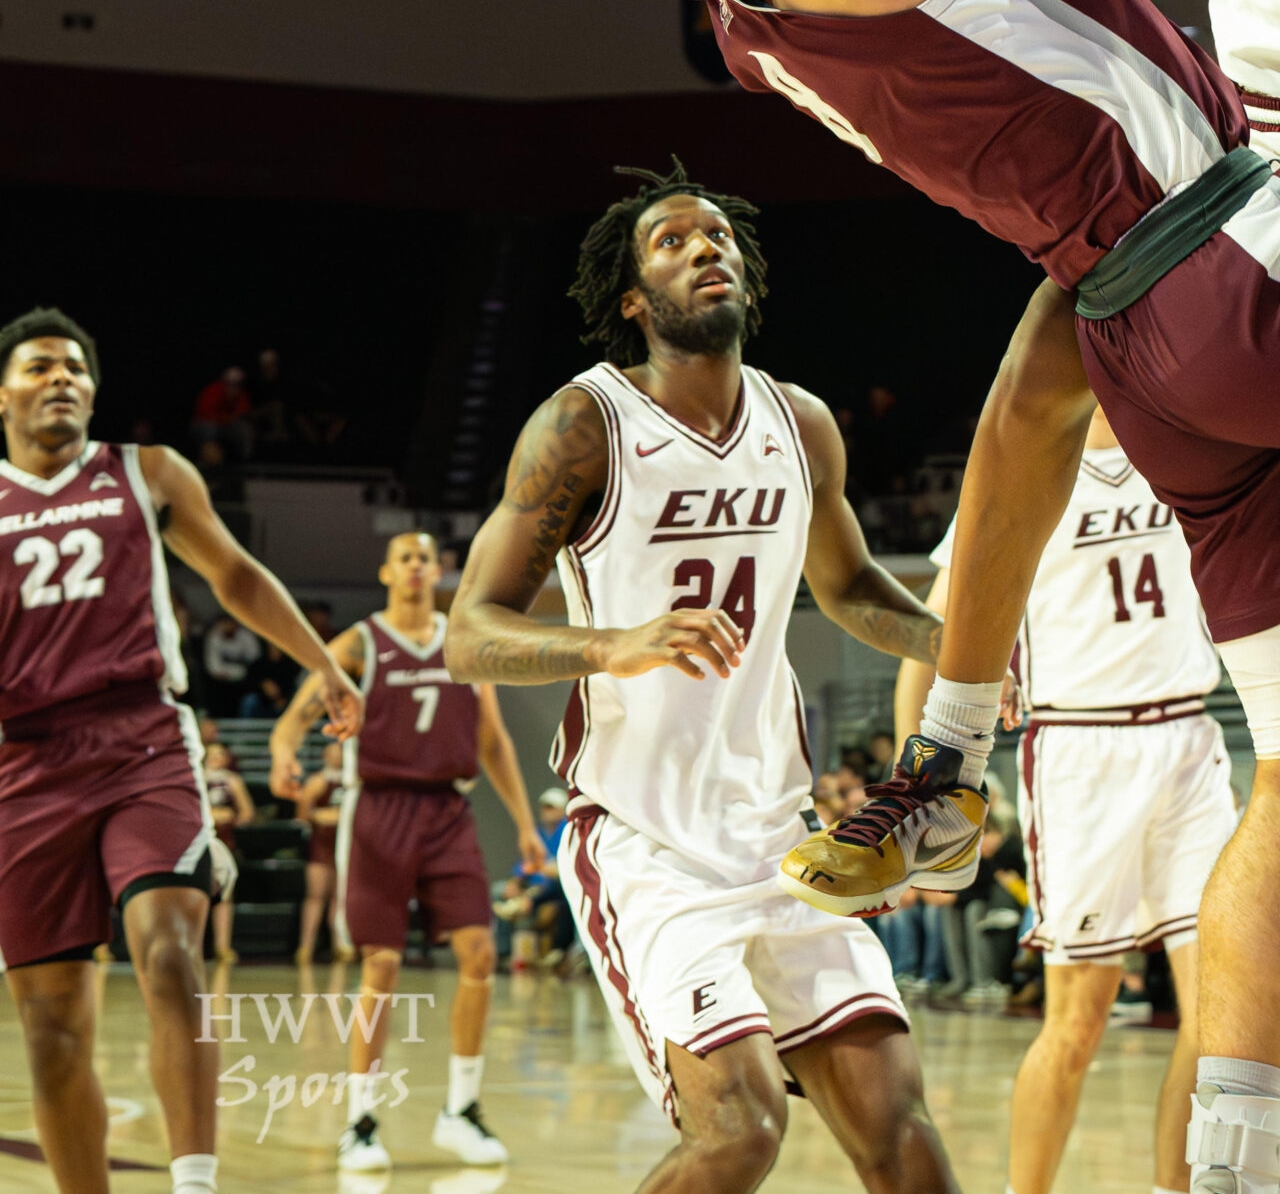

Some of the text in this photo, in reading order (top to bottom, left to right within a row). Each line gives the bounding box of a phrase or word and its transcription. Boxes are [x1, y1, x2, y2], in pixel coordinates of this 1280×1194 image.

[654, 488, 786, 529] EKU
[1076, 503, 1174, 538] EKU
[14, 528, 105, 610] 22
[1108, 553, 1166, 622] 14
[411, 686, 440, 734] 7
[692, 981, 717, 1015] E
